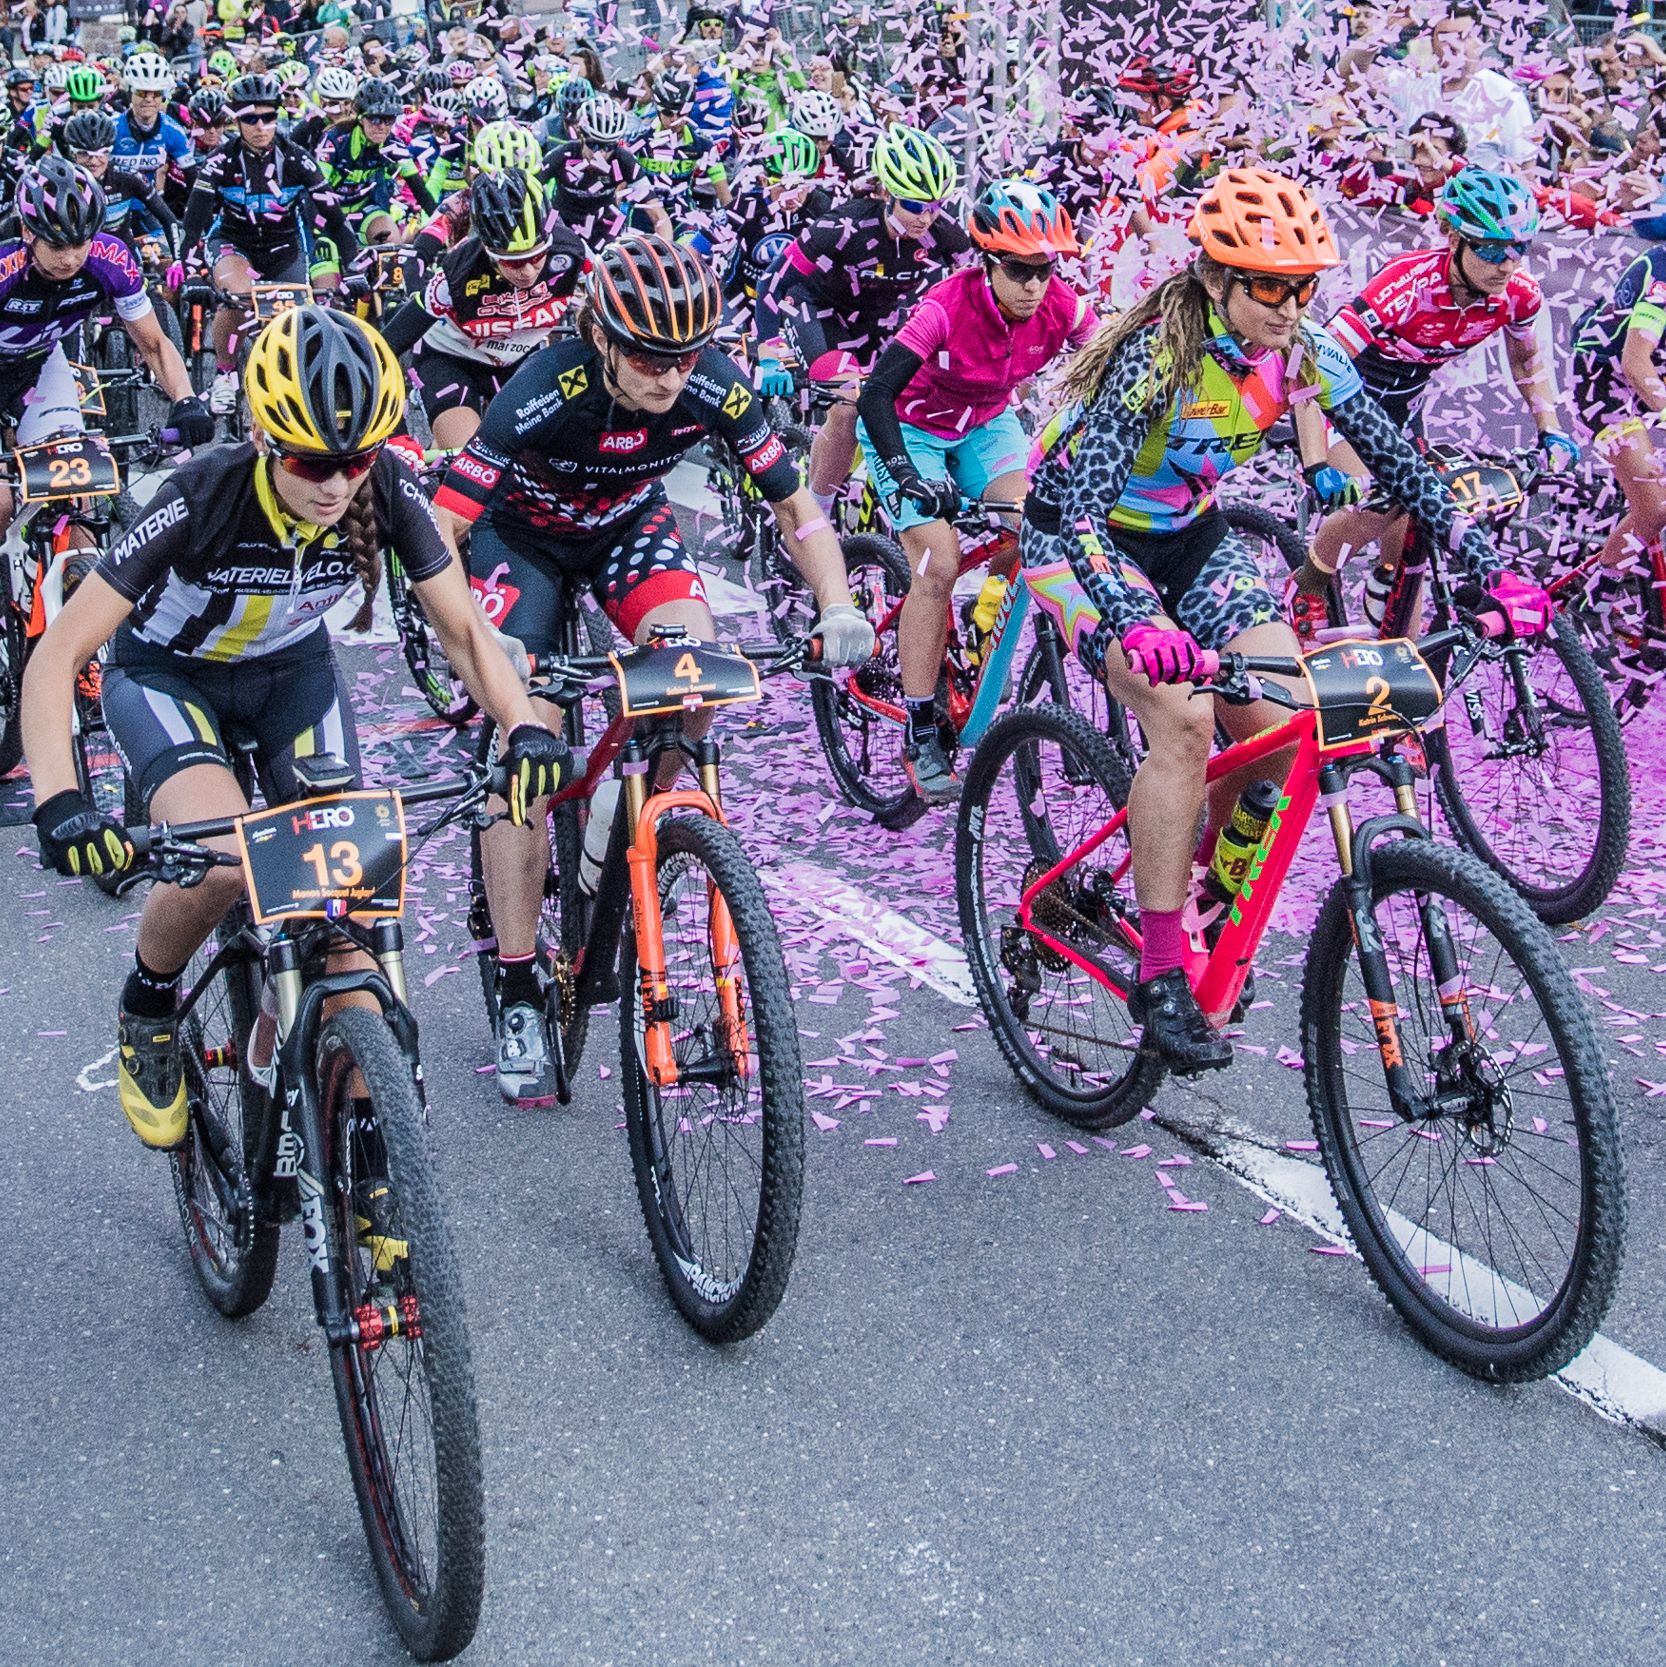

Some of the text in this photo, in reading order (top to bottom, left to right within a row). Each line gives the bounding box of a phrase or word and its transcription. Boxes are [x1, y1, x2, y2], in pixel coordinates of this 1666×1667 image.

[486, 339, 531, 354] marzoc
[515, 389, 560, 420] Raiffeisen
[698, 387, 723, 409] Bank
[514, 397, 564, 436] Meine Bank
[47, 442, 84, 456] HERO
[48, 457, 93, 488] 23
[454, 456, 497, 484] ARBÖ
[1451, 470, 1482, 501] 17
[673, 652, 703, 684] 4
[1340, 648, 1384, 671] HERO
[1365, 675, 1393, 717] 2
[291, 805, 356, 836] HERO
[302, 839, 364, 888] 13
